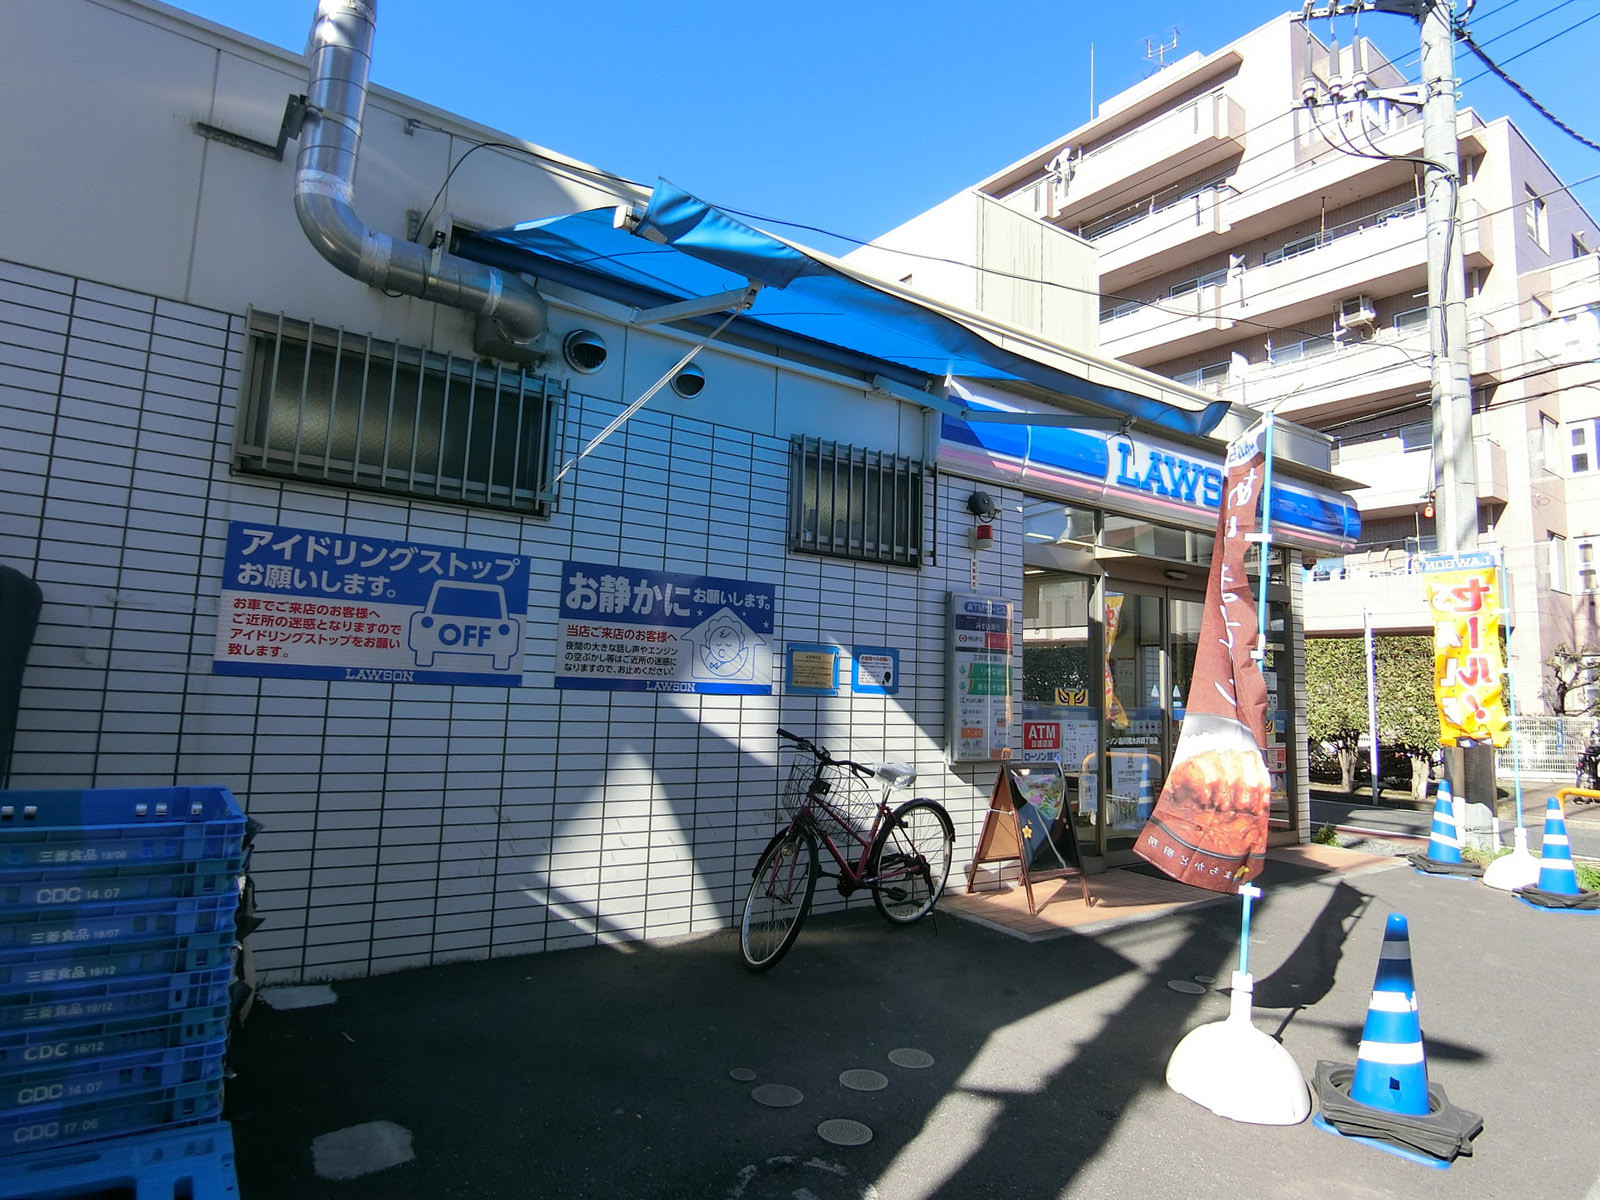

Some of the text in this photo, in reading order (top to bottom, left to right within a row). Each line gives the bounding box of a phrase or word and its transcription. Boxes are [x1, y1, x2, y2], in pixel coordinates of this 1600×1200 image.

[1117, 442, 1222, 508] LAWS
[241, 528, 520, 581] アイドリングストップ
[237, 562, 397, 598] お願いします。
[566, 572, 770, 617] お静かに お願いします。
[233, 598, 381, 619] お車でご来店のお客様へ
[232, 613, 401, 636] ご近所の迷惑となりますので
[566, 624, 677, 643] 当店ご来店のお客様へ
[230, 628, 401, 649] アイドリングストップをお願い
[438, 623, 492, 648] OFF
[228, 643, 289, 659] 致します。
[565, 641, 678, 655] 夜間の大きな話し声やエンジン
[565, 652, 677, 666] の空ぶかし等はご近所の迷惑に
[345, 668, 414, 682] LAWSON
[646, 680, 696, 692] LAWSON
[1028, 725, 1056, 739] ATM
[39, 848, 98, 863] 三菱食品
[36, 887, 121, 904] CDC 14.07
[30, 928, 89, 944] 三菱食品
[25, 966, 86, 983] 三菱食品
[23, 1002, 82, 1020] 三菱食品
[24, 1043, 68, 1061] CDC
[18, 1081, 103, 1104] CDC 14.07
[14, 1122, 59, 1143] CDC
